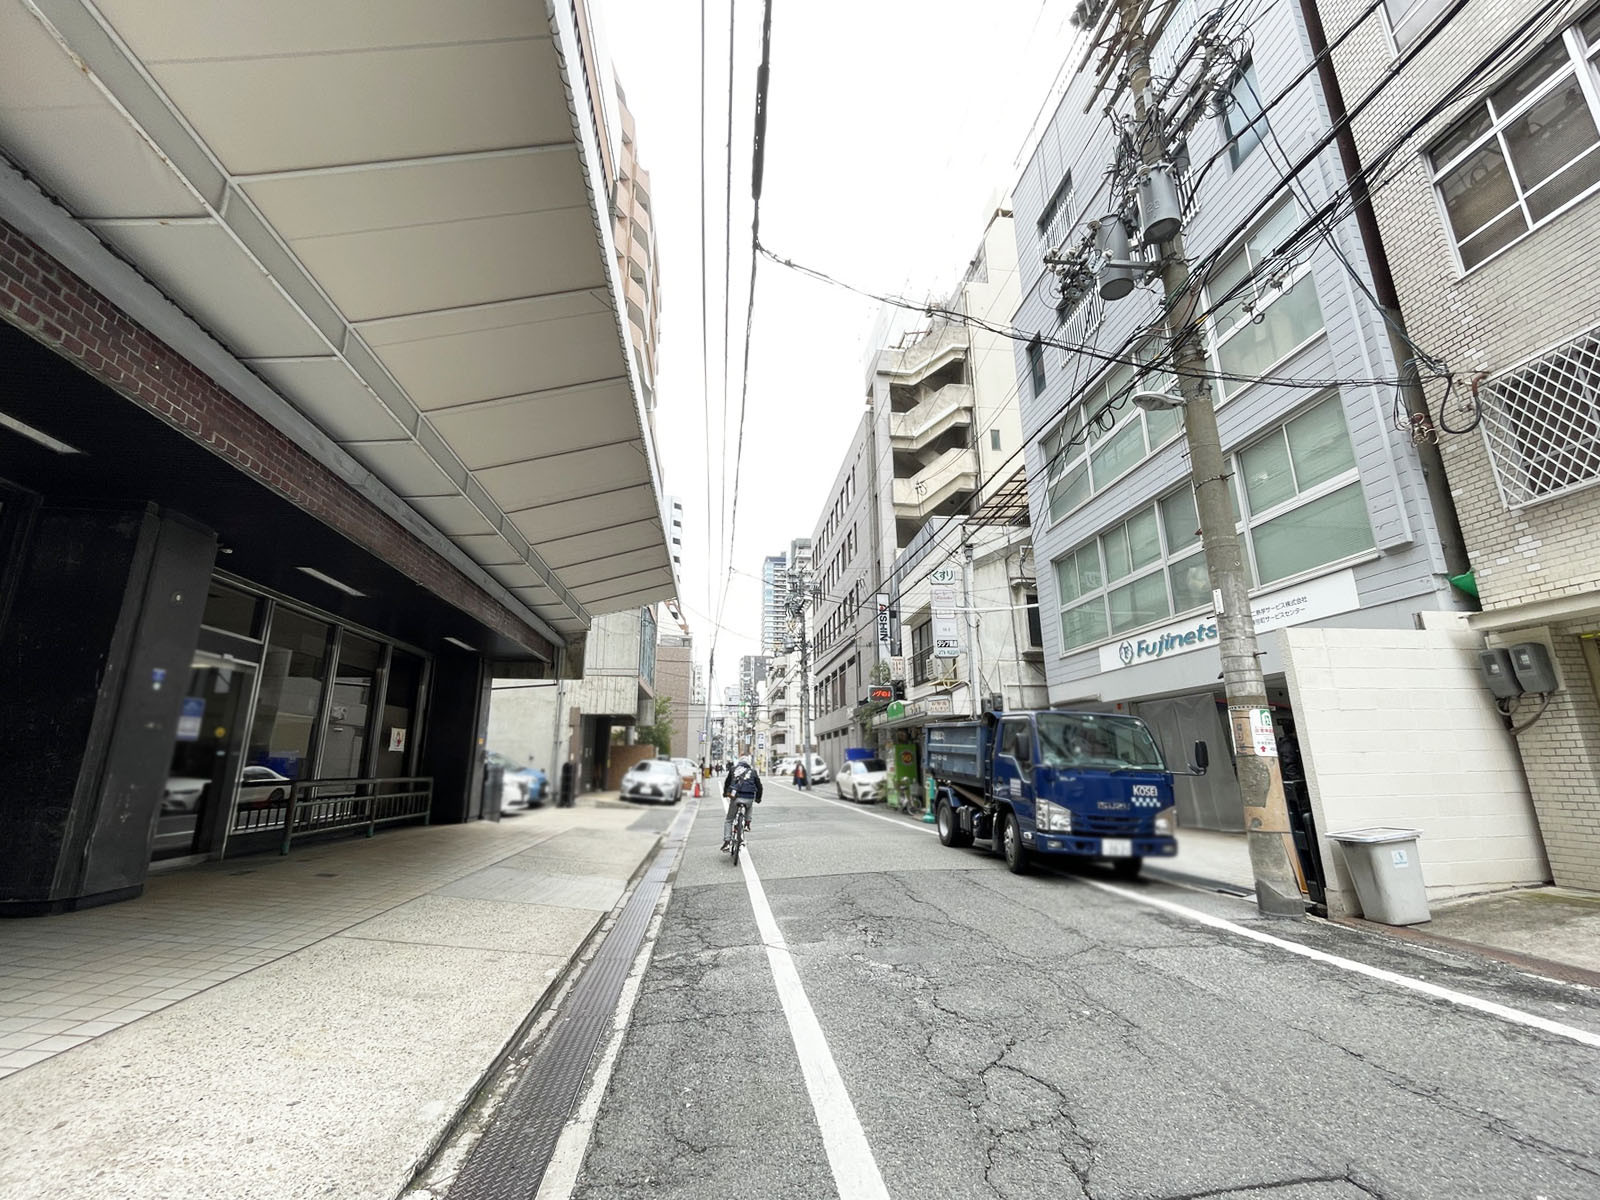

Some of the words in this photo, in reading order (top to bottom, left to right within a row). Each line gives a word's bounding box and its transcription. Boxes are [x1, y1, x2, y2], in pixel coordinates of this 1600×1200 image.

[933, 570, 954, 581] くすり
[1136, 623, 1218, 658] Fujinets
[1132, 785, 1158, 797] KOSEI
